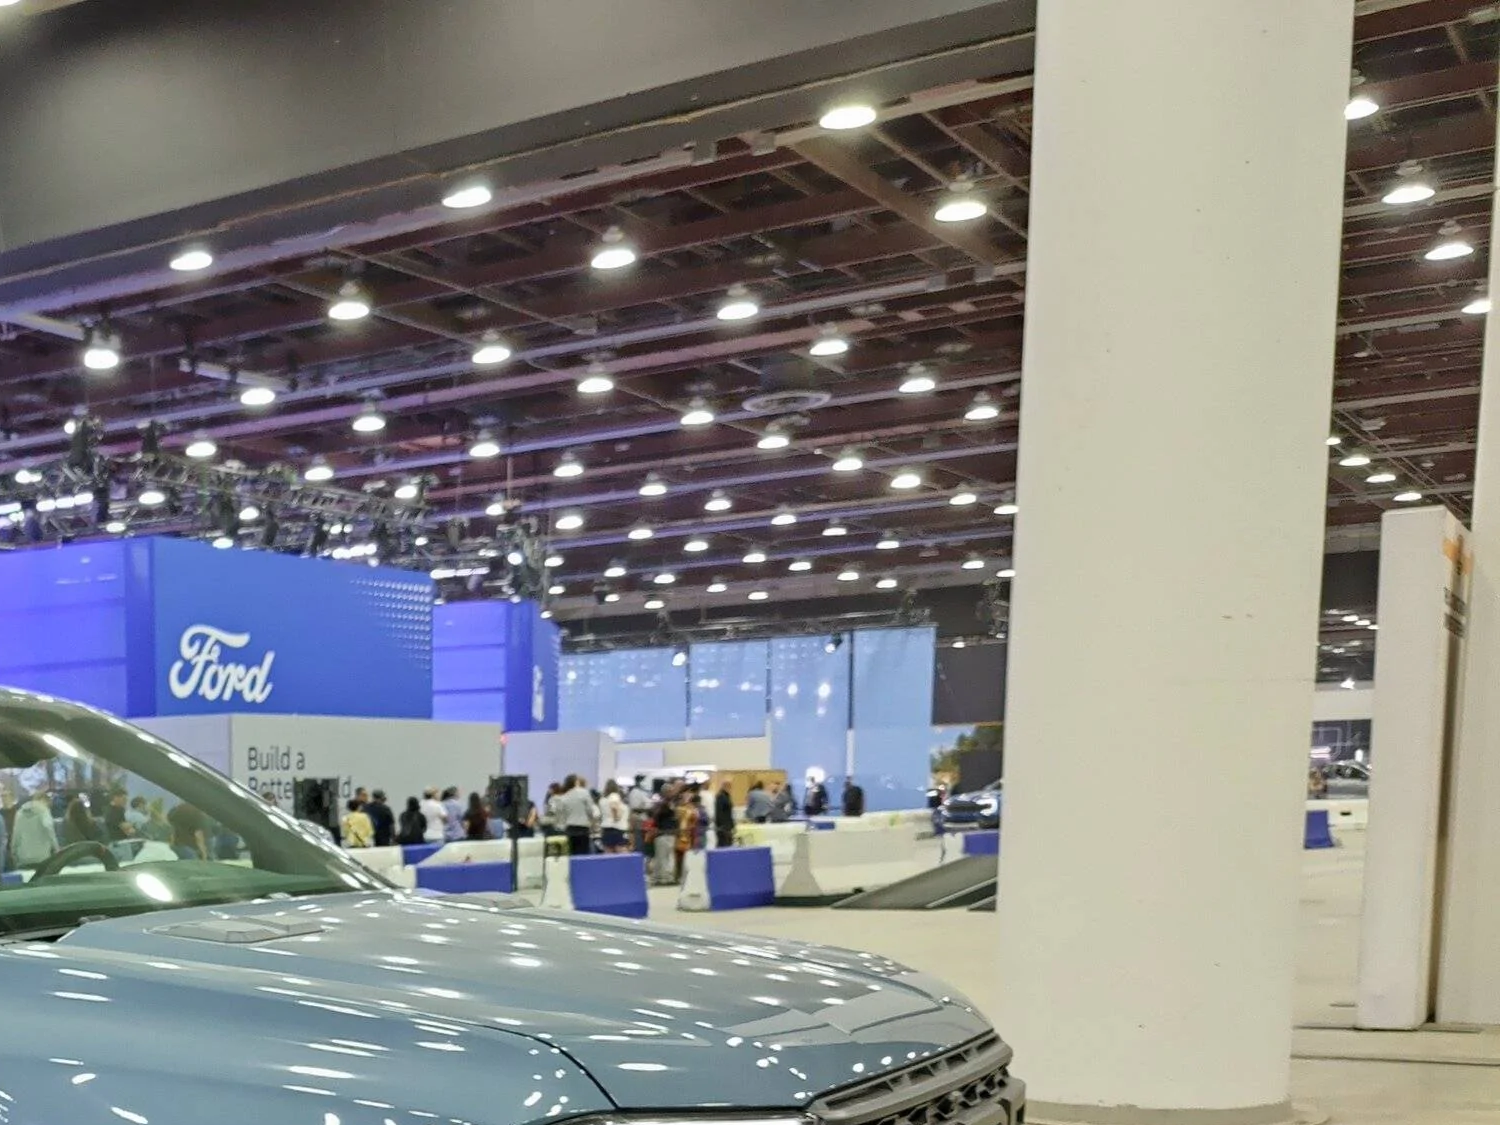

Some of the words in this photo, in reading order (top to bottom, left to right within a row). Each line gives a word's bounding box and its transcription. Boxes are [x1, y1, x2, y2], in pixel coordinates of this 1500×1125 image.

[169, 624, 275, 703] Ford
[248, 746, 290, 771] Build
[296, 752, 305, 771] a
[248, 777, 293, 800] Bette
